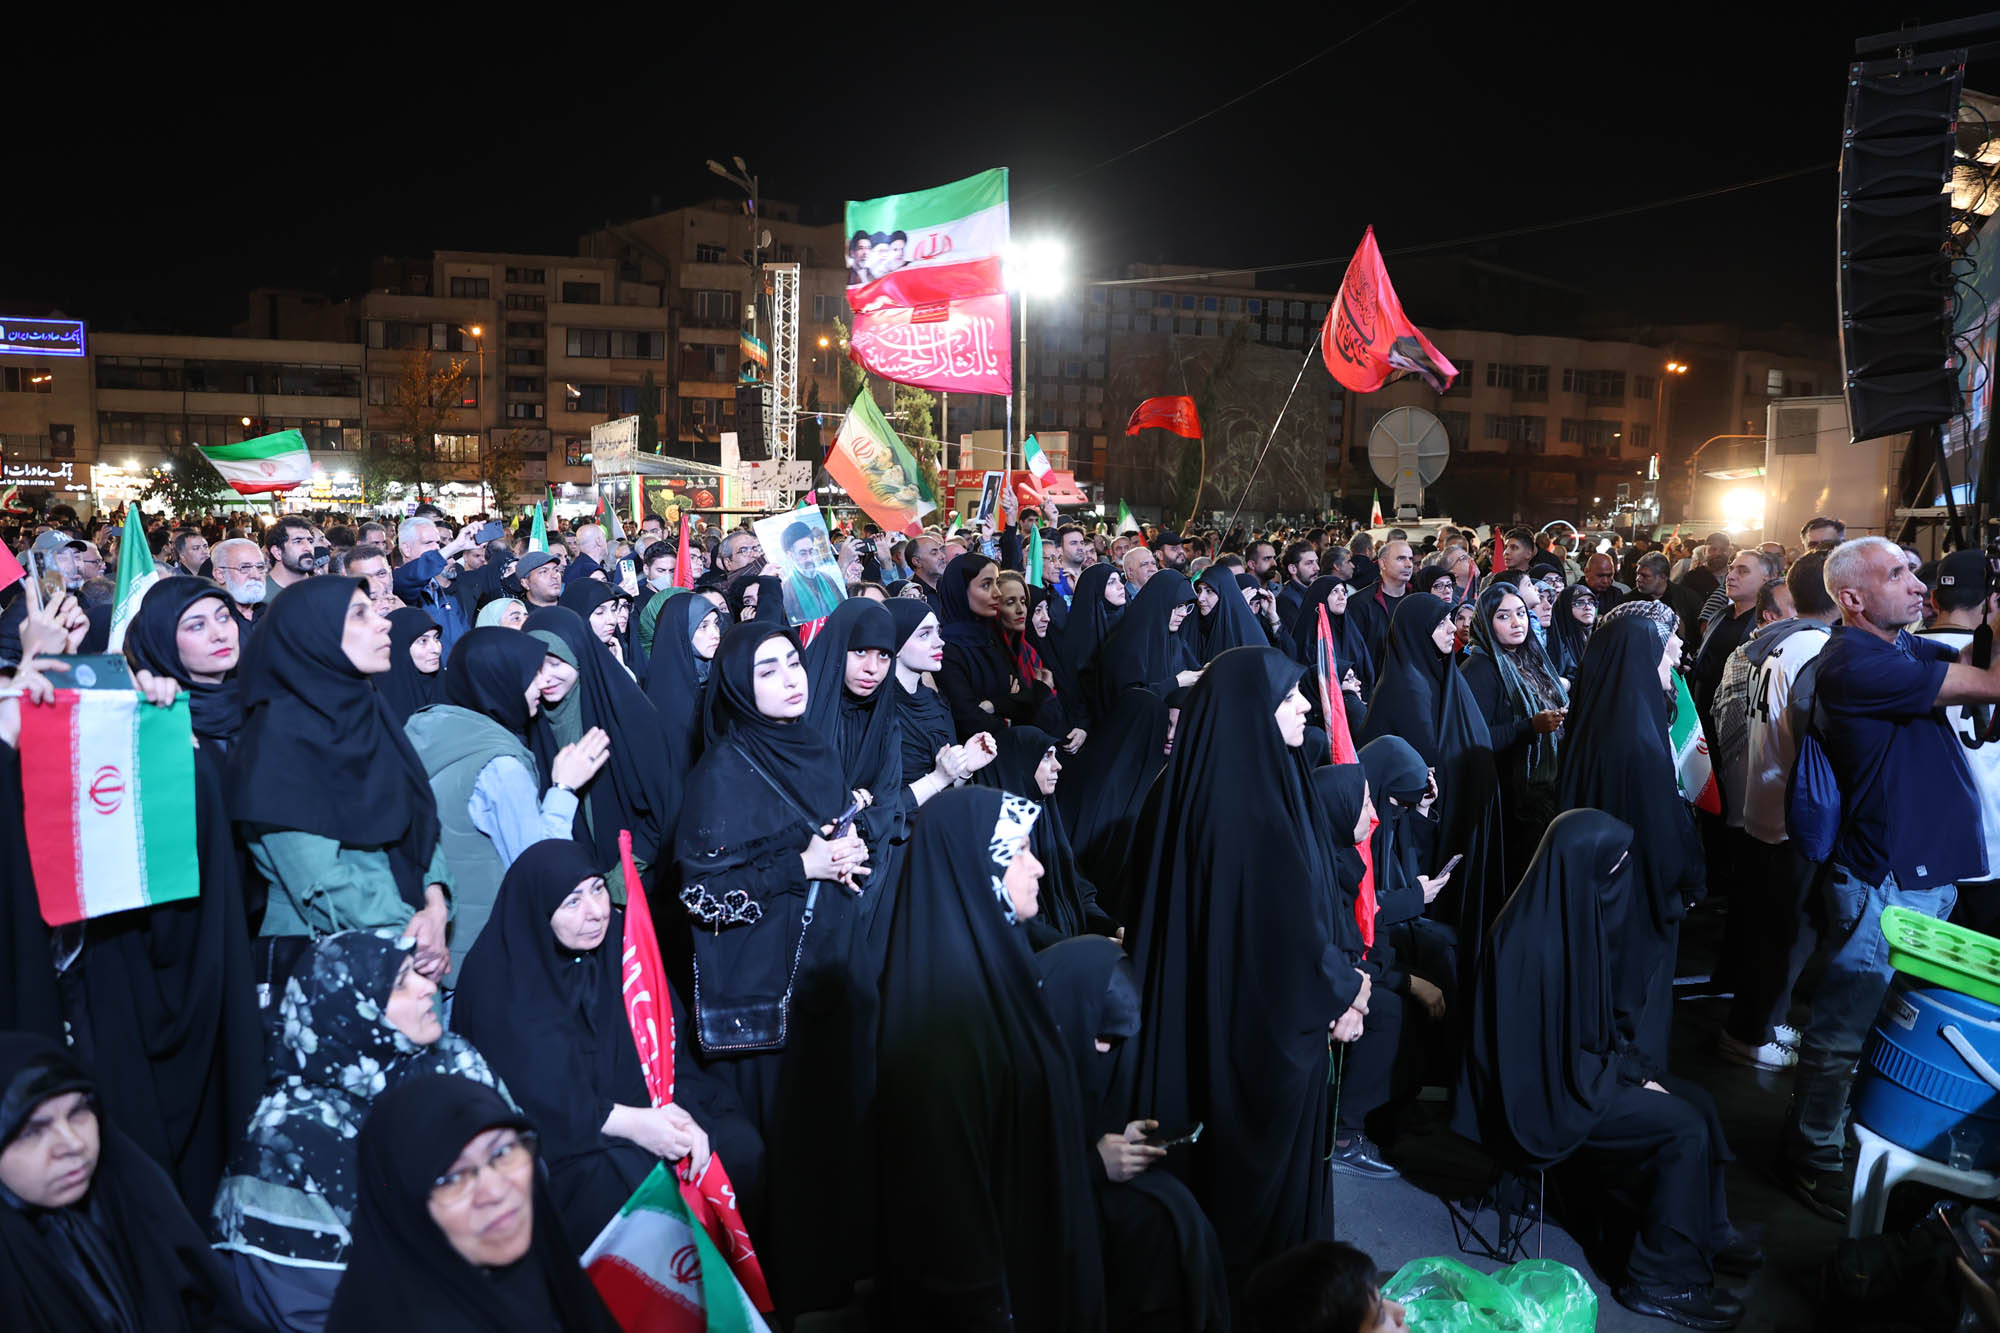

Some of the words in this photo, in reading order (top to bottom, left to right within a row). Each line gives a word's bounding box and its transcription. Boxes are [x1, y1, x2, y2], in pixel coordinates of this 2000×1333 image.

[8, 331, 30, 341] ایران
[30, 331, 60, 341] صادرات
[60, 328, 80, 345] بانک
[8, 463, 48, 477] صادرات
[48, 462, 73, 481] بانک
